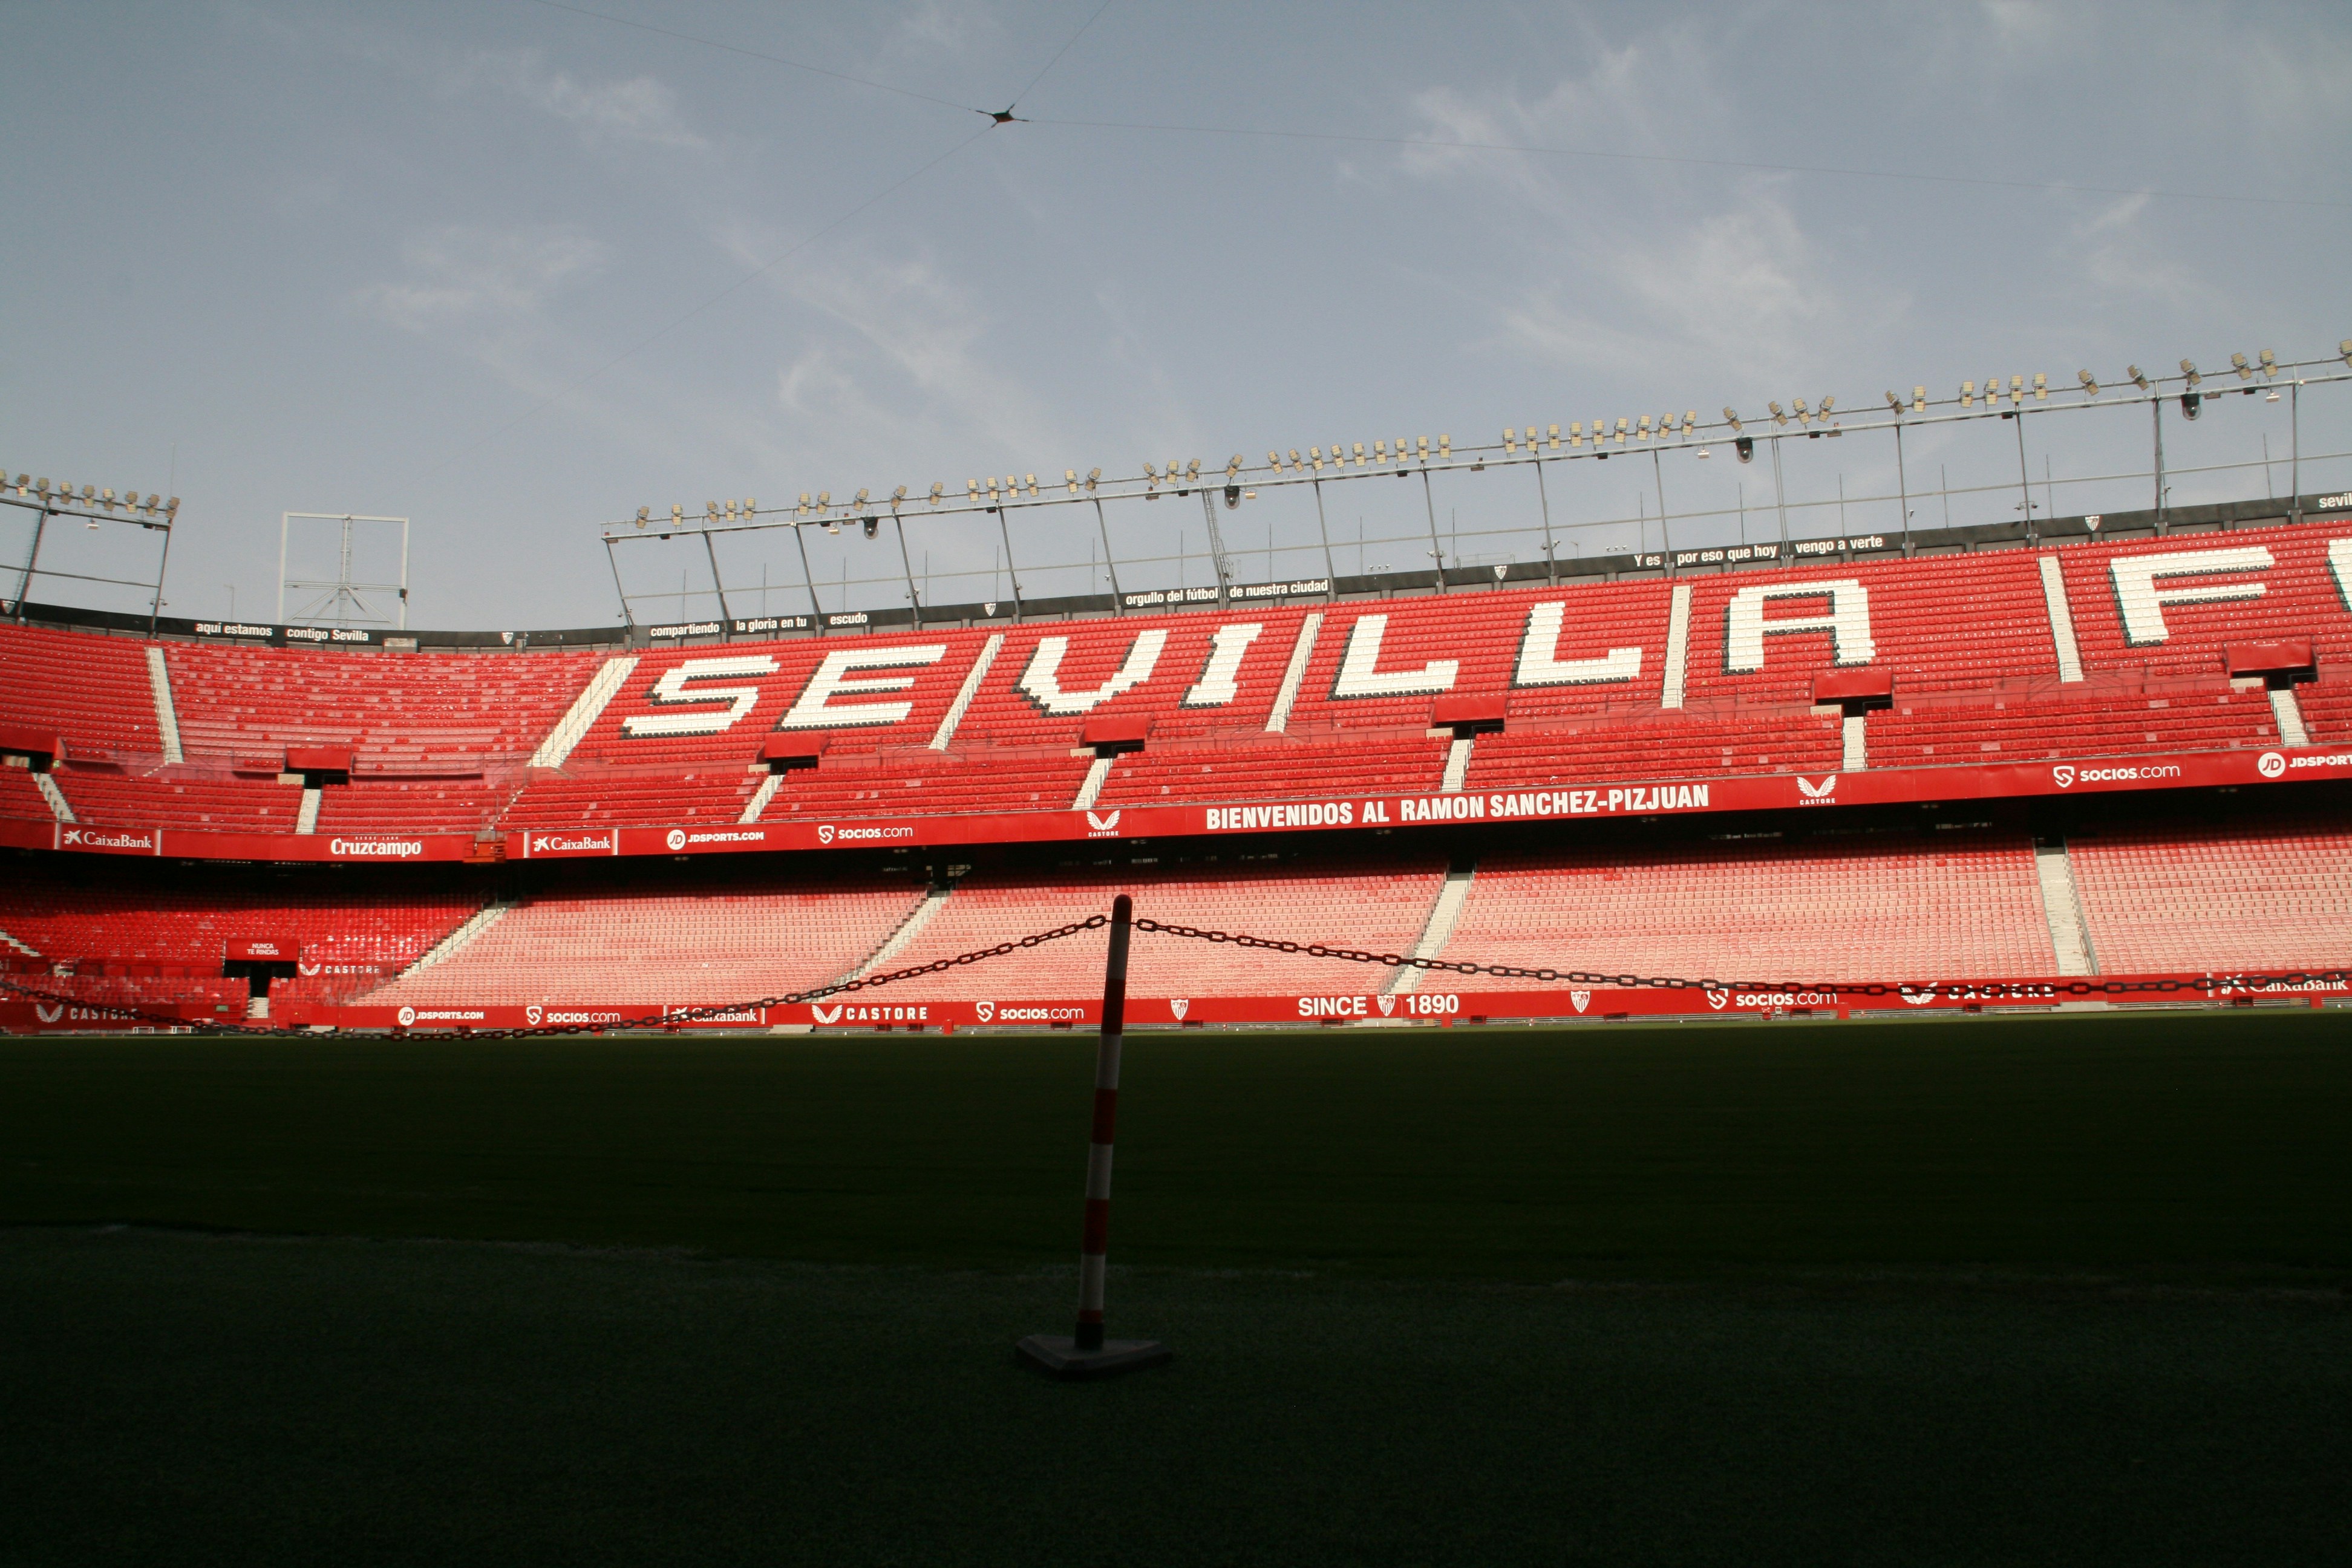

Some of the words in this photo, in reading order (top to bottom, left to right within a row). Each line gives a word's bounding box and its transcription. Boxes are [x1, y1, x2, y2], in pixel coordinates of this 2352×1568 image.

[1634, 554, 1642, 567] Y
[1646, 555, 1661, 566] es
[1677, 552, 1698, 566] por
[1702, 550, 1723, 562] eso
[1727, 548, 1751, 563] que
[1754, 544, 1777, 559] hoy
[1795, 540, 1834, 555] vengo
[1838, 539, 1846, 550] a
[1849, 536, 1883, 549] verte
[1126, 592, 1164, 607] orgullo
[1167, 590, 1183, 602] del
[1186, 586, 1218, 601] fútbol
[1230, 586, 1243, 598] de
[1246, 583, 1287, 596] nuestra
[1291, 579, 1328, 593] ciudad
[197, 622, 221, 635] aquí
[224, 624, 273, 636] estamos
[287, 628, 328, 641] contigo
[332, 630, 369, 641] Sevilla
[650, 622, 719, 638] compartiendo
[736, 620, 745, 631] la
[748, 618, 777, 633] gloria
[781, 619, 794, 629] en
[796, 616, 807, 627] tu
[830, 612, 867, 625] escudo
[2262, 759, 2281, 771] JD
[1206, 802, 1353, 829] BIENVENIDOS
[1362, 801, 1390, 823] AL
[1400, 795, 1484, 821] RAMON
[1490, 785, 1709, 817] SANCHEZ-PIZJUAN
[84, 832, 152, 848] CaixaBank
[331, 838, 422, 857] Cruzcampo
[550, 836, 610, 850] CaixaBank
[670, 835, 683, 844] JD
[688, 832, 764, 843] JDSPORTS.COM
[325, 965, 379, 974] CASTORE
[846, 1007, 927, 1020] CASTORE
[1298, 996, 1367, 1016] SINCE
[1406, 995, 1459, 1014] 1890
